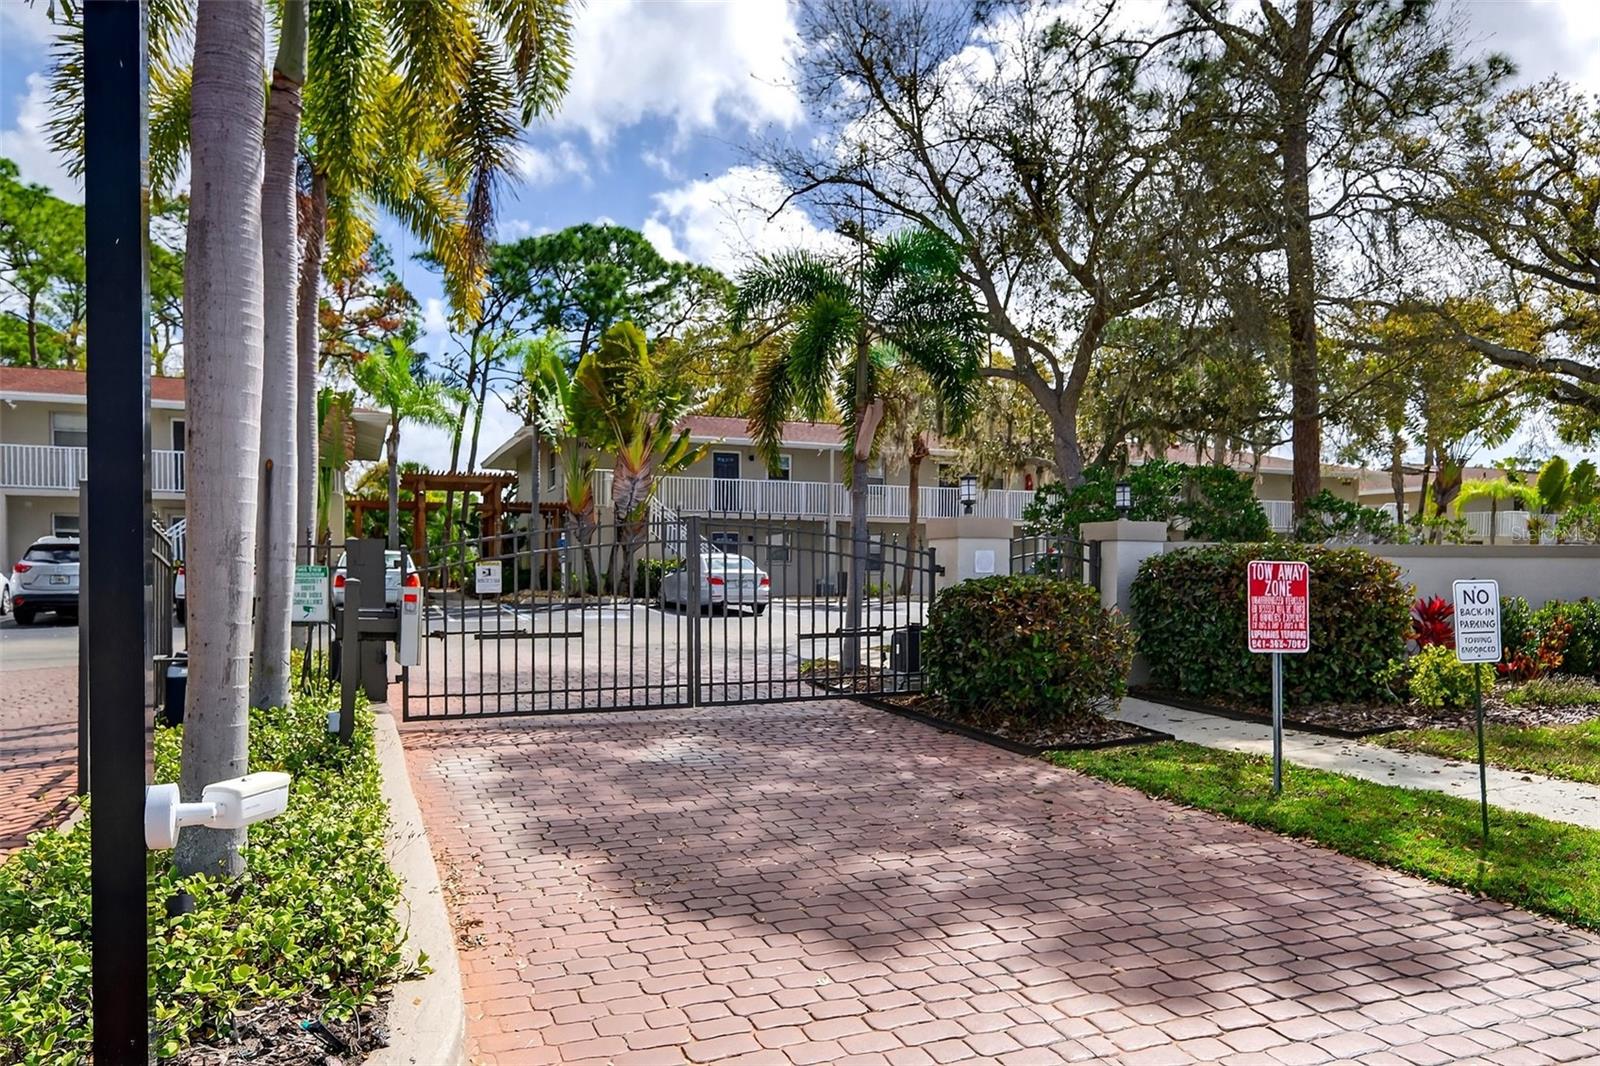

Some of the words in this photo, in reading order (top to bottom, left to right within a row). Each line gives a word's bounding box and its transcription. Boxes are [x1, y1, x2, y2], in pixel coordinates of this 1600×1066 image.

[1252, 564, 1274, 580] TOW
[1278, 565, 1305, 581] AWAY
[1264, 581, 1292, 596] ZONE
[1462, 589, 1490, 605] NO
[1459, 607, 1495, 617] BACK-IN
[1459, 619, 1496, 629] PARKING
[1464, 636, 1493, 644] TOWING
[1461, 646, 1496, 654] ENFORCED
